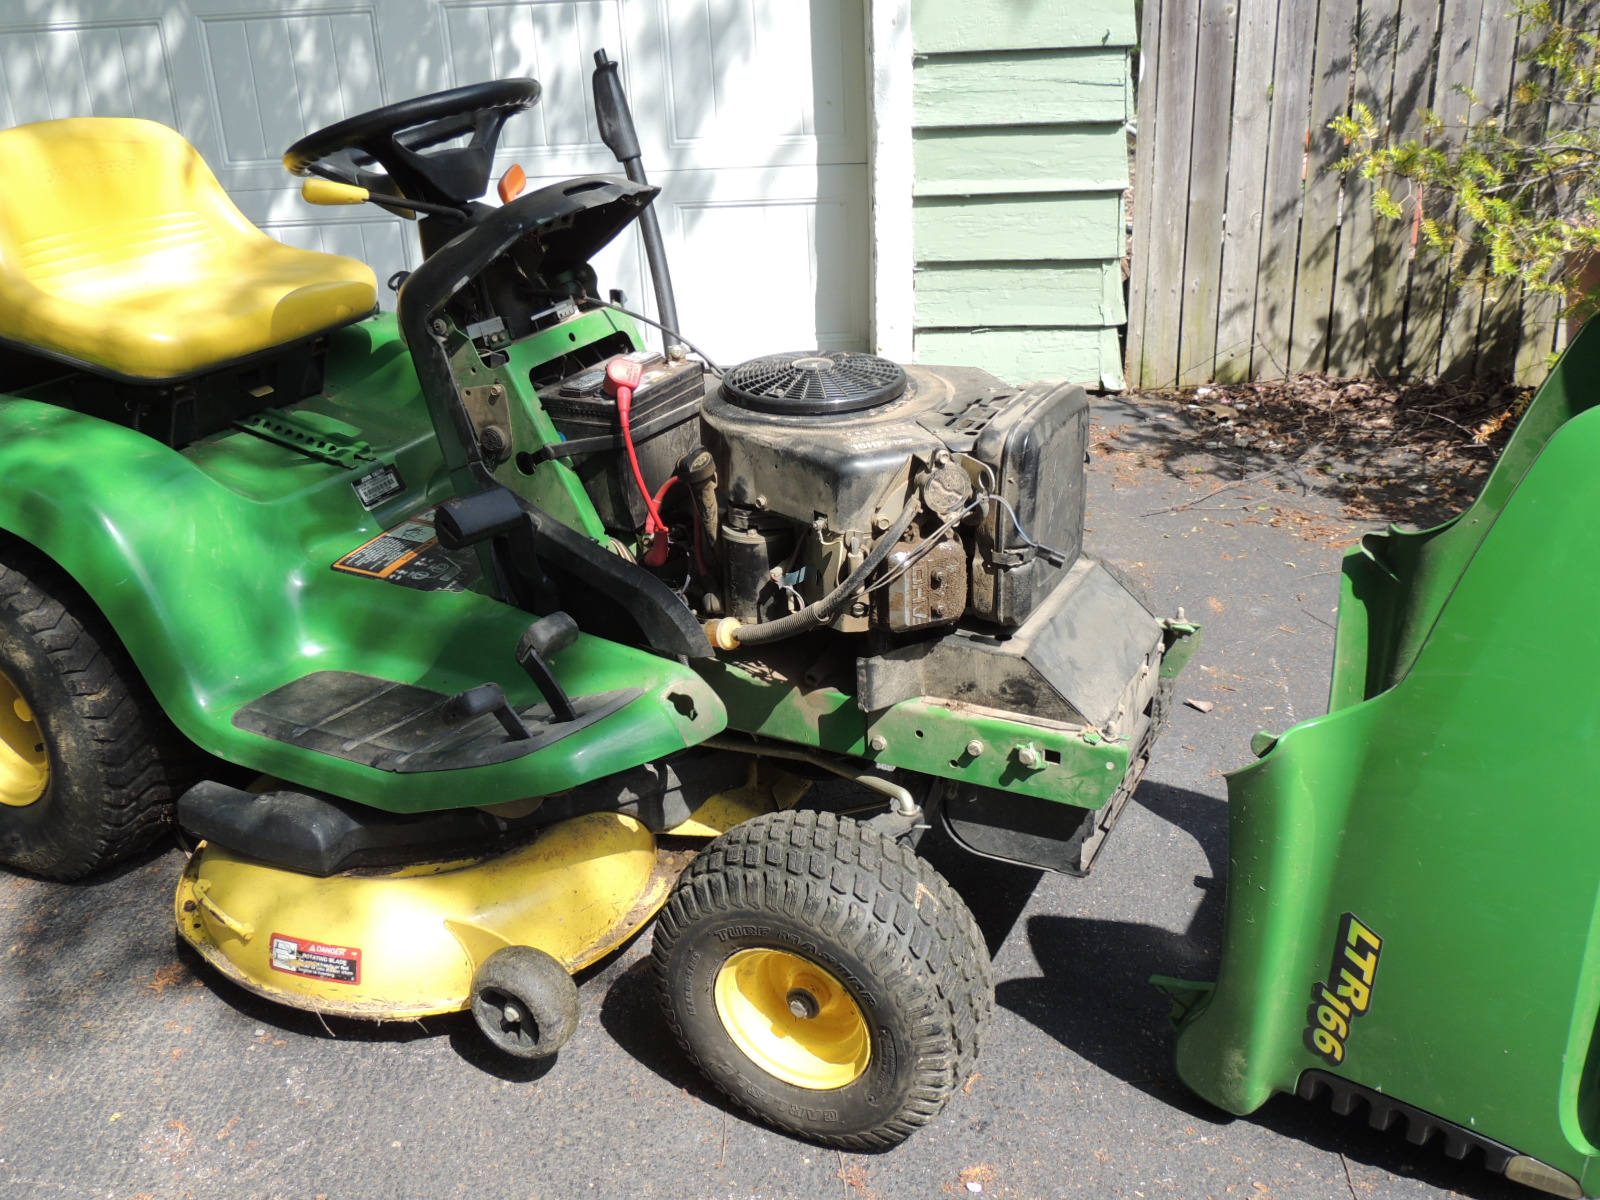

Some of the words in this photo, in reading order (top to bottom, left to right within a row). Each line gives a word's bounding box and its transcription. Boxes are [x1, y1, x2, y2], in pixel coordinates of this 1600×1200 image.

[317, 945, 346, 956] DANGER
[714, 926, 770, 943] TURF
[778, 931, 876, 1006] MASTER
